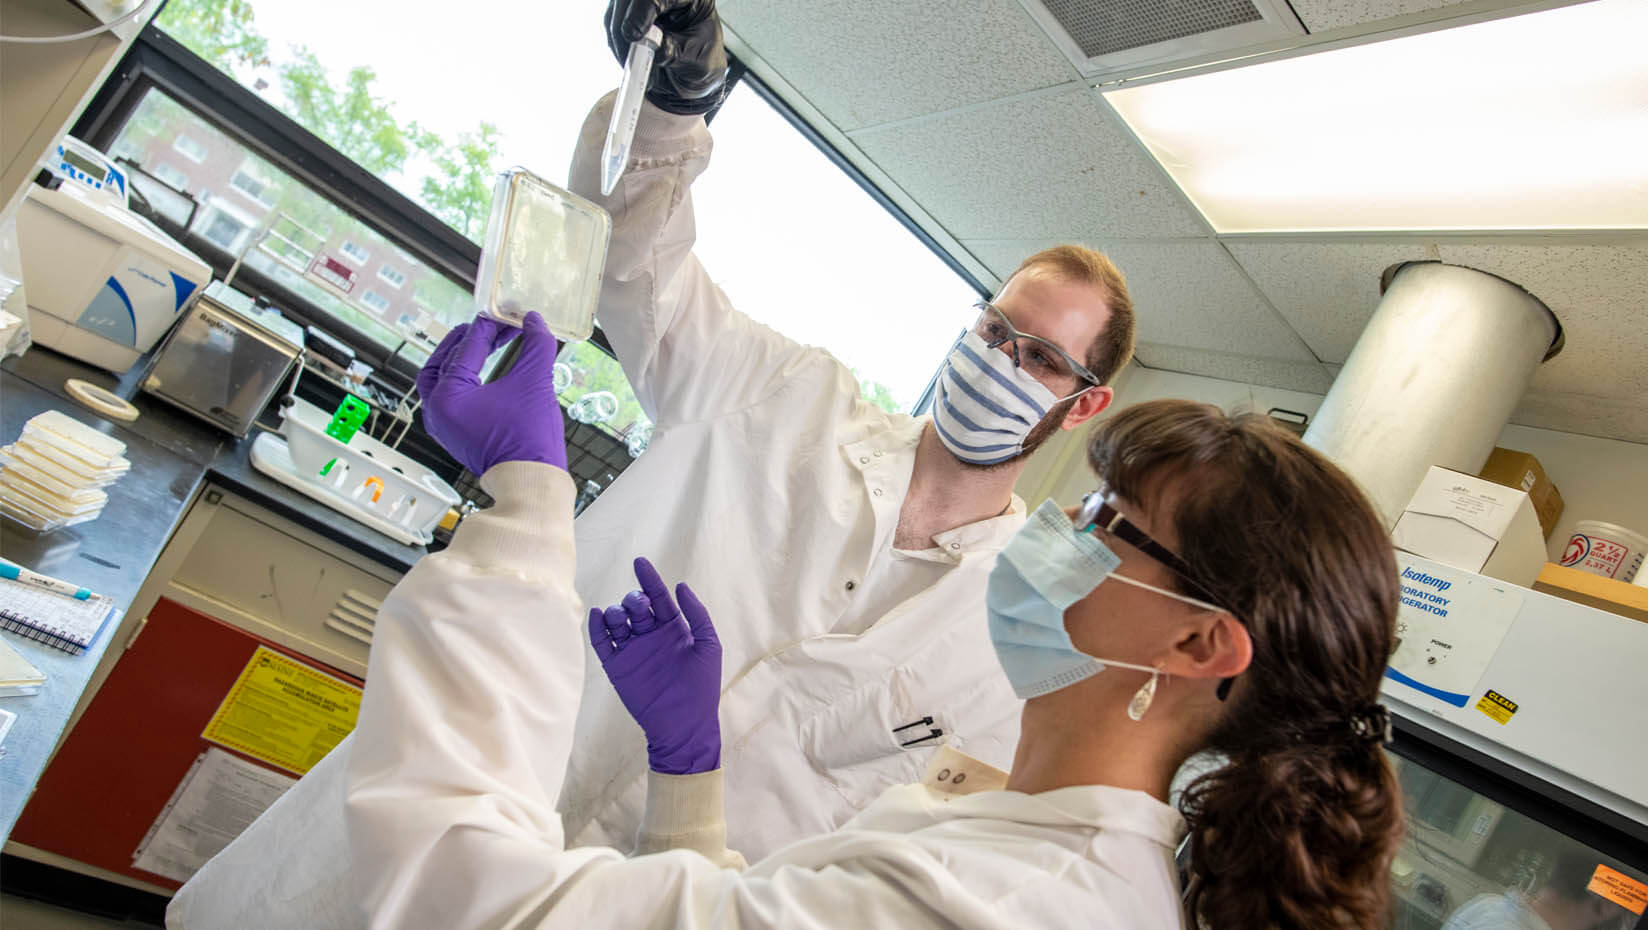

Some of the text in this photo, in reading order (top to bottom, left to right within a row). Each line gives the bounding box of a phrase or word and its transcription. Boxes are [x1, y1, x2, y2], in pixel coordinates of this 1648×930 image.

[1593, 542, 1606, 552] 2
[1589, 550, 1619, 564] QUART
[1401, 566, 1452, 592] Isotemp
[1399, 584, 1451, 607] BORATORY
[1399, 595, 1448, 618] IGERATOR
[1430, 639, 1452, 650] POWER
[1489, 692, 1516, 711] CLEAN
